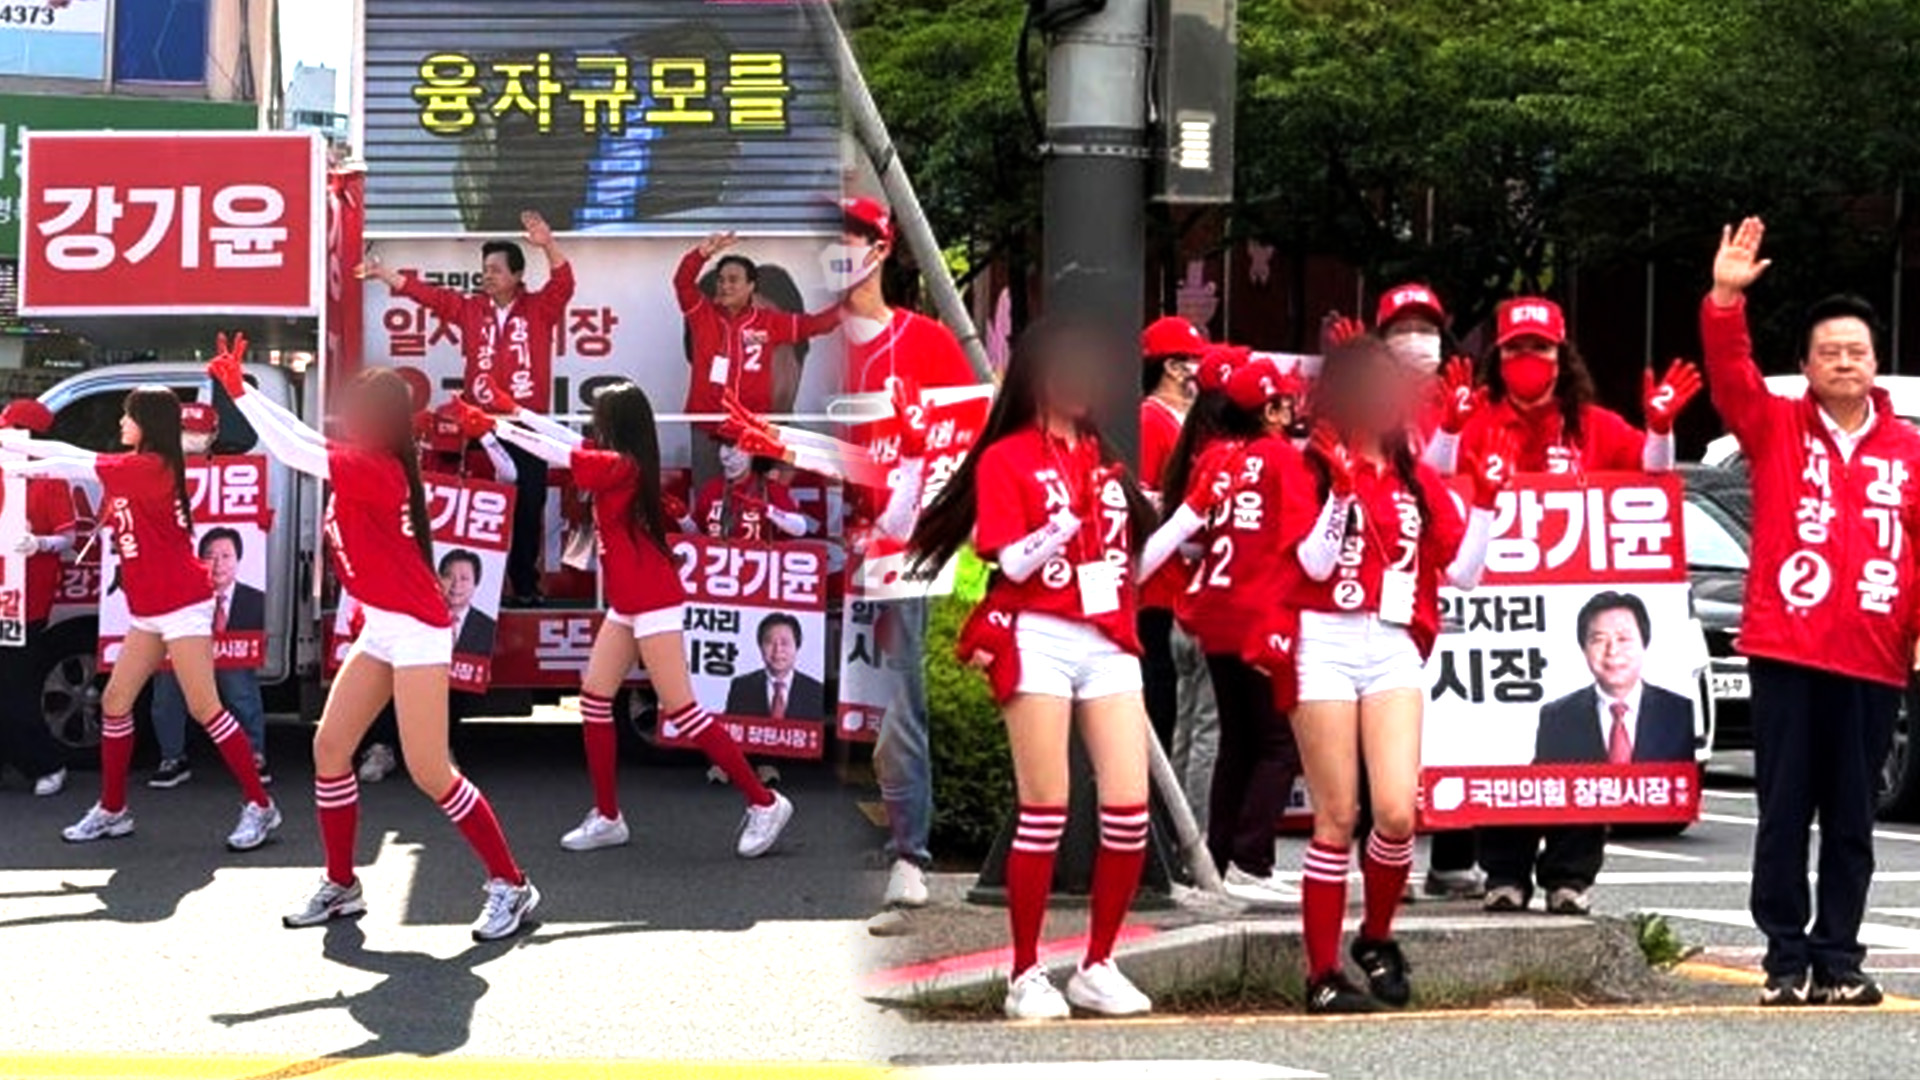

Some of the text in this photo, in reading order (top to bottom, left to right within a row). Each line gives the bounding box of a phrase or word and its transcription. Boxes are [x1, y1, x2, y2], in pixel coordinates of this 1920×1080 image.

[37, 184, 288, 271] 강기윤
[508, 316, 535, 399] 강기윤
[743, 343, 763, 371] 2
[906, 405, 926, 430] 2
[1455, 386, 1472, 412] 2
[1651, 384, 1675, 412] 2
[1485, 454, 1504, 481] 2
[1484, 486, 1673, 572] 강기윤
[1785, 454, 1837, 602] 시장 2
[1856, 455, 1910, 615] 강기윤
[704, 547, 819, 603] 강기윤
[1209, 536, 1234, 587] 2
[1337, 582, 1360, 606] 2
[1437, 594, 1547, 634] 일자리
[1430, 647, 1549, 704] 시장
[1469, 777, 1567, 808] 국민의힘
[1573, 777, 1671, 808] 창원시장
